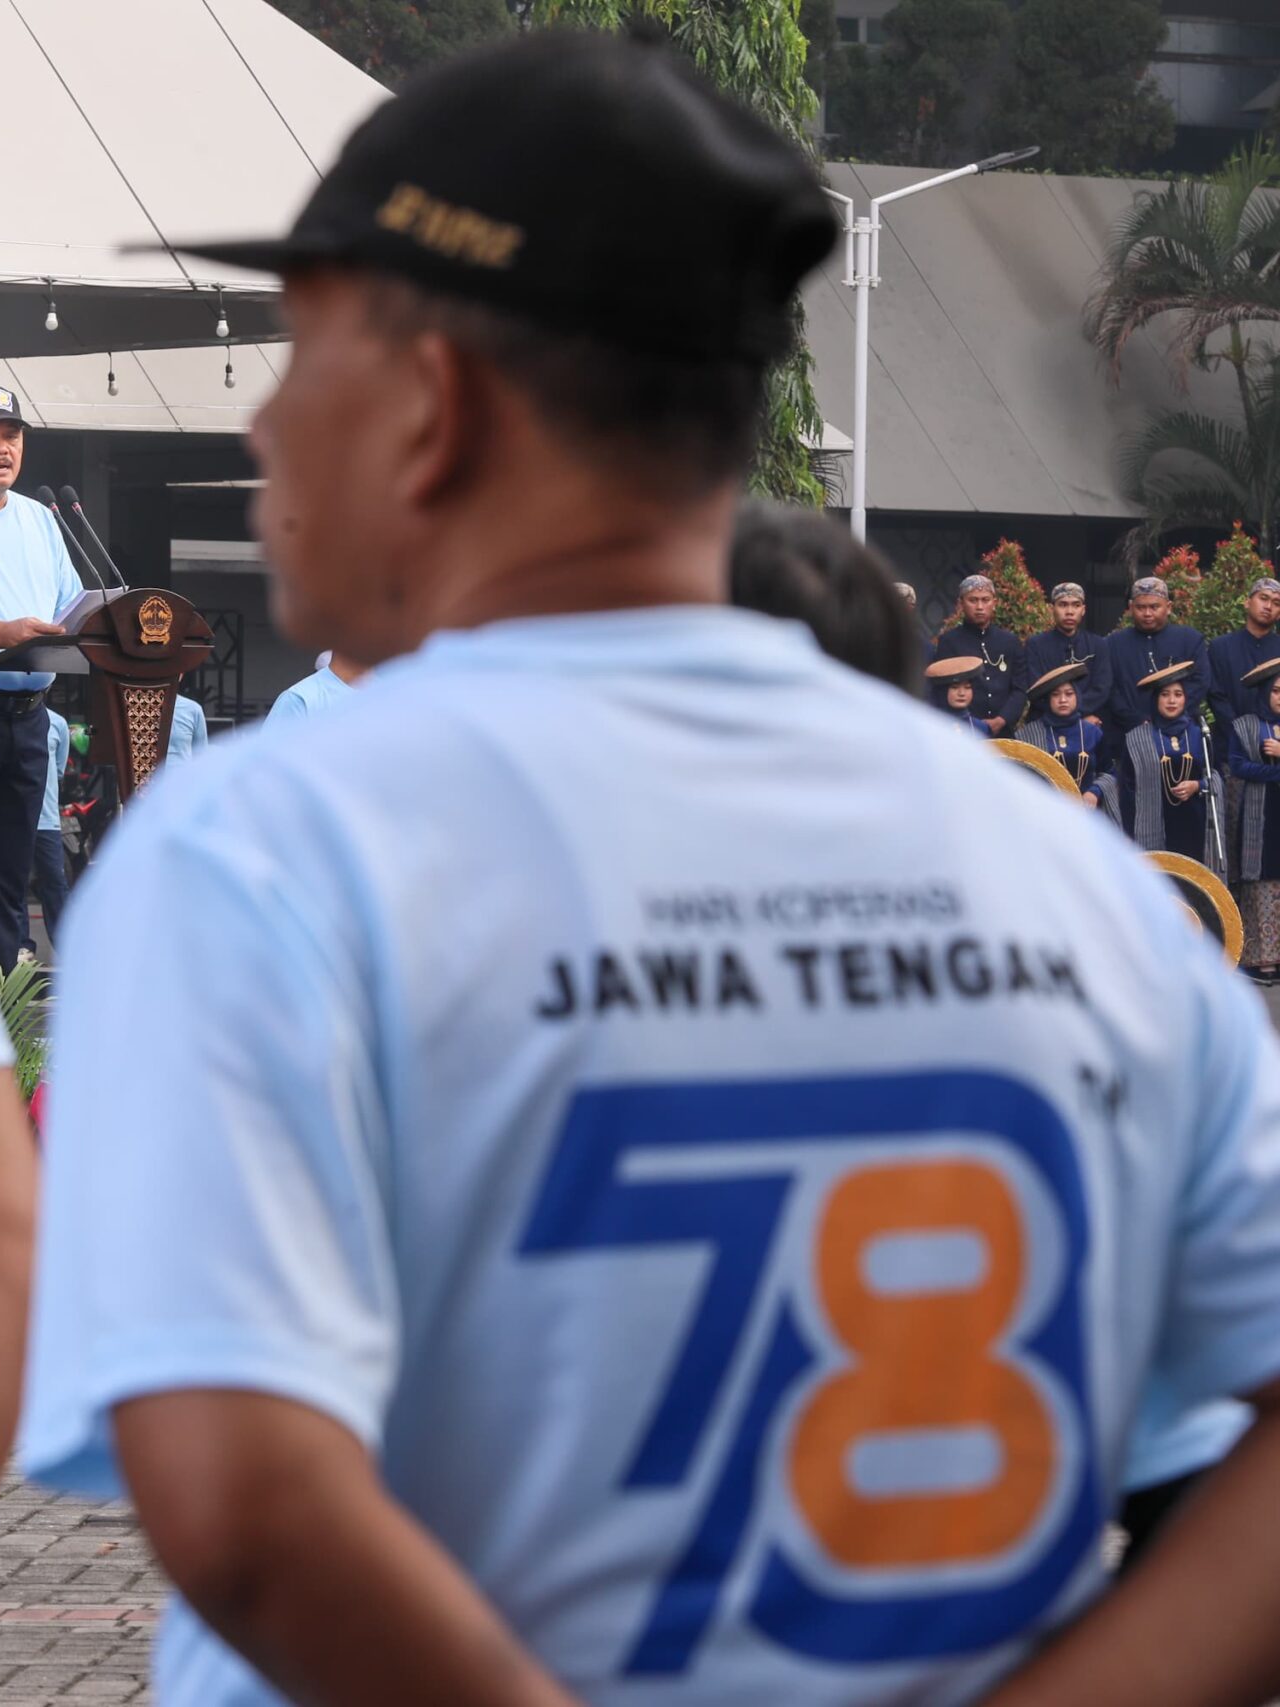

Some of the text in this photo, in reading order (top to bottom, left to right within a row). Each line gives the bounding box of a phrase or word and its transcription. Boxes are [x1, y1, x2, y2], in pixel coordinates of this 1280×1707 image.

[536, 934, 1086, 1022] JAWA TENGAH
[514, 1064, 1104, 1684] 78
